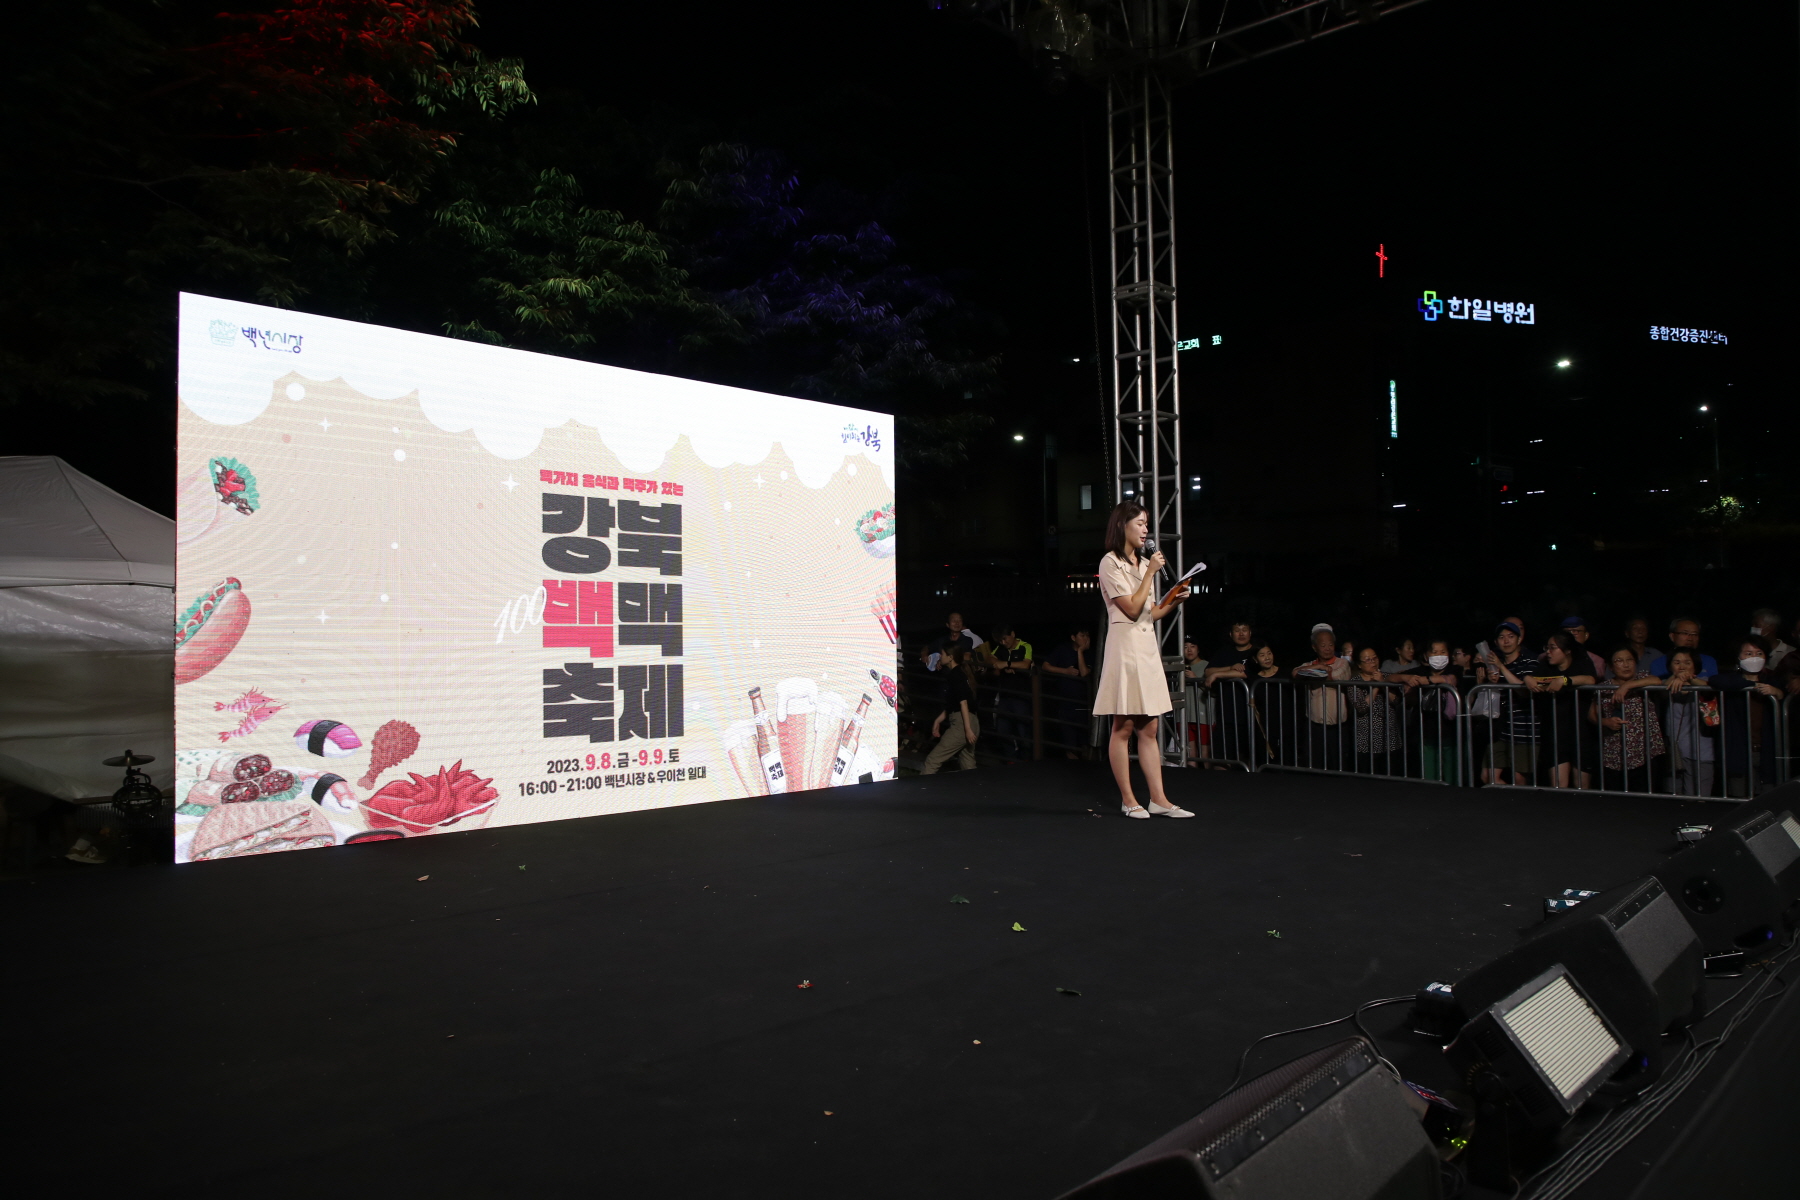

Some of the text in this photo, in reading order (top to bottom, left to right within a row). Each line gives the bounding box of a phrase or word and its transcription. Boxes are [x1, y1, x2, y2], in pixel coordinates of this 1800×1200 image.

[1447, 296, 1535, 325] 한일병원
[860, 425, 881, 452] 강북
[582, 474, 619, 490] 음식과
[541, 493, 683, 576] 강북
[493, 585, 548, 645] 100
[542, 579, 684, 658] 백맥
[542, 662, 685, 744] 축제
[604, 772, 647, 789] 백년시장
[656, 768, 686, 783] 우이천
[687, 766, 707, 781] 일대
